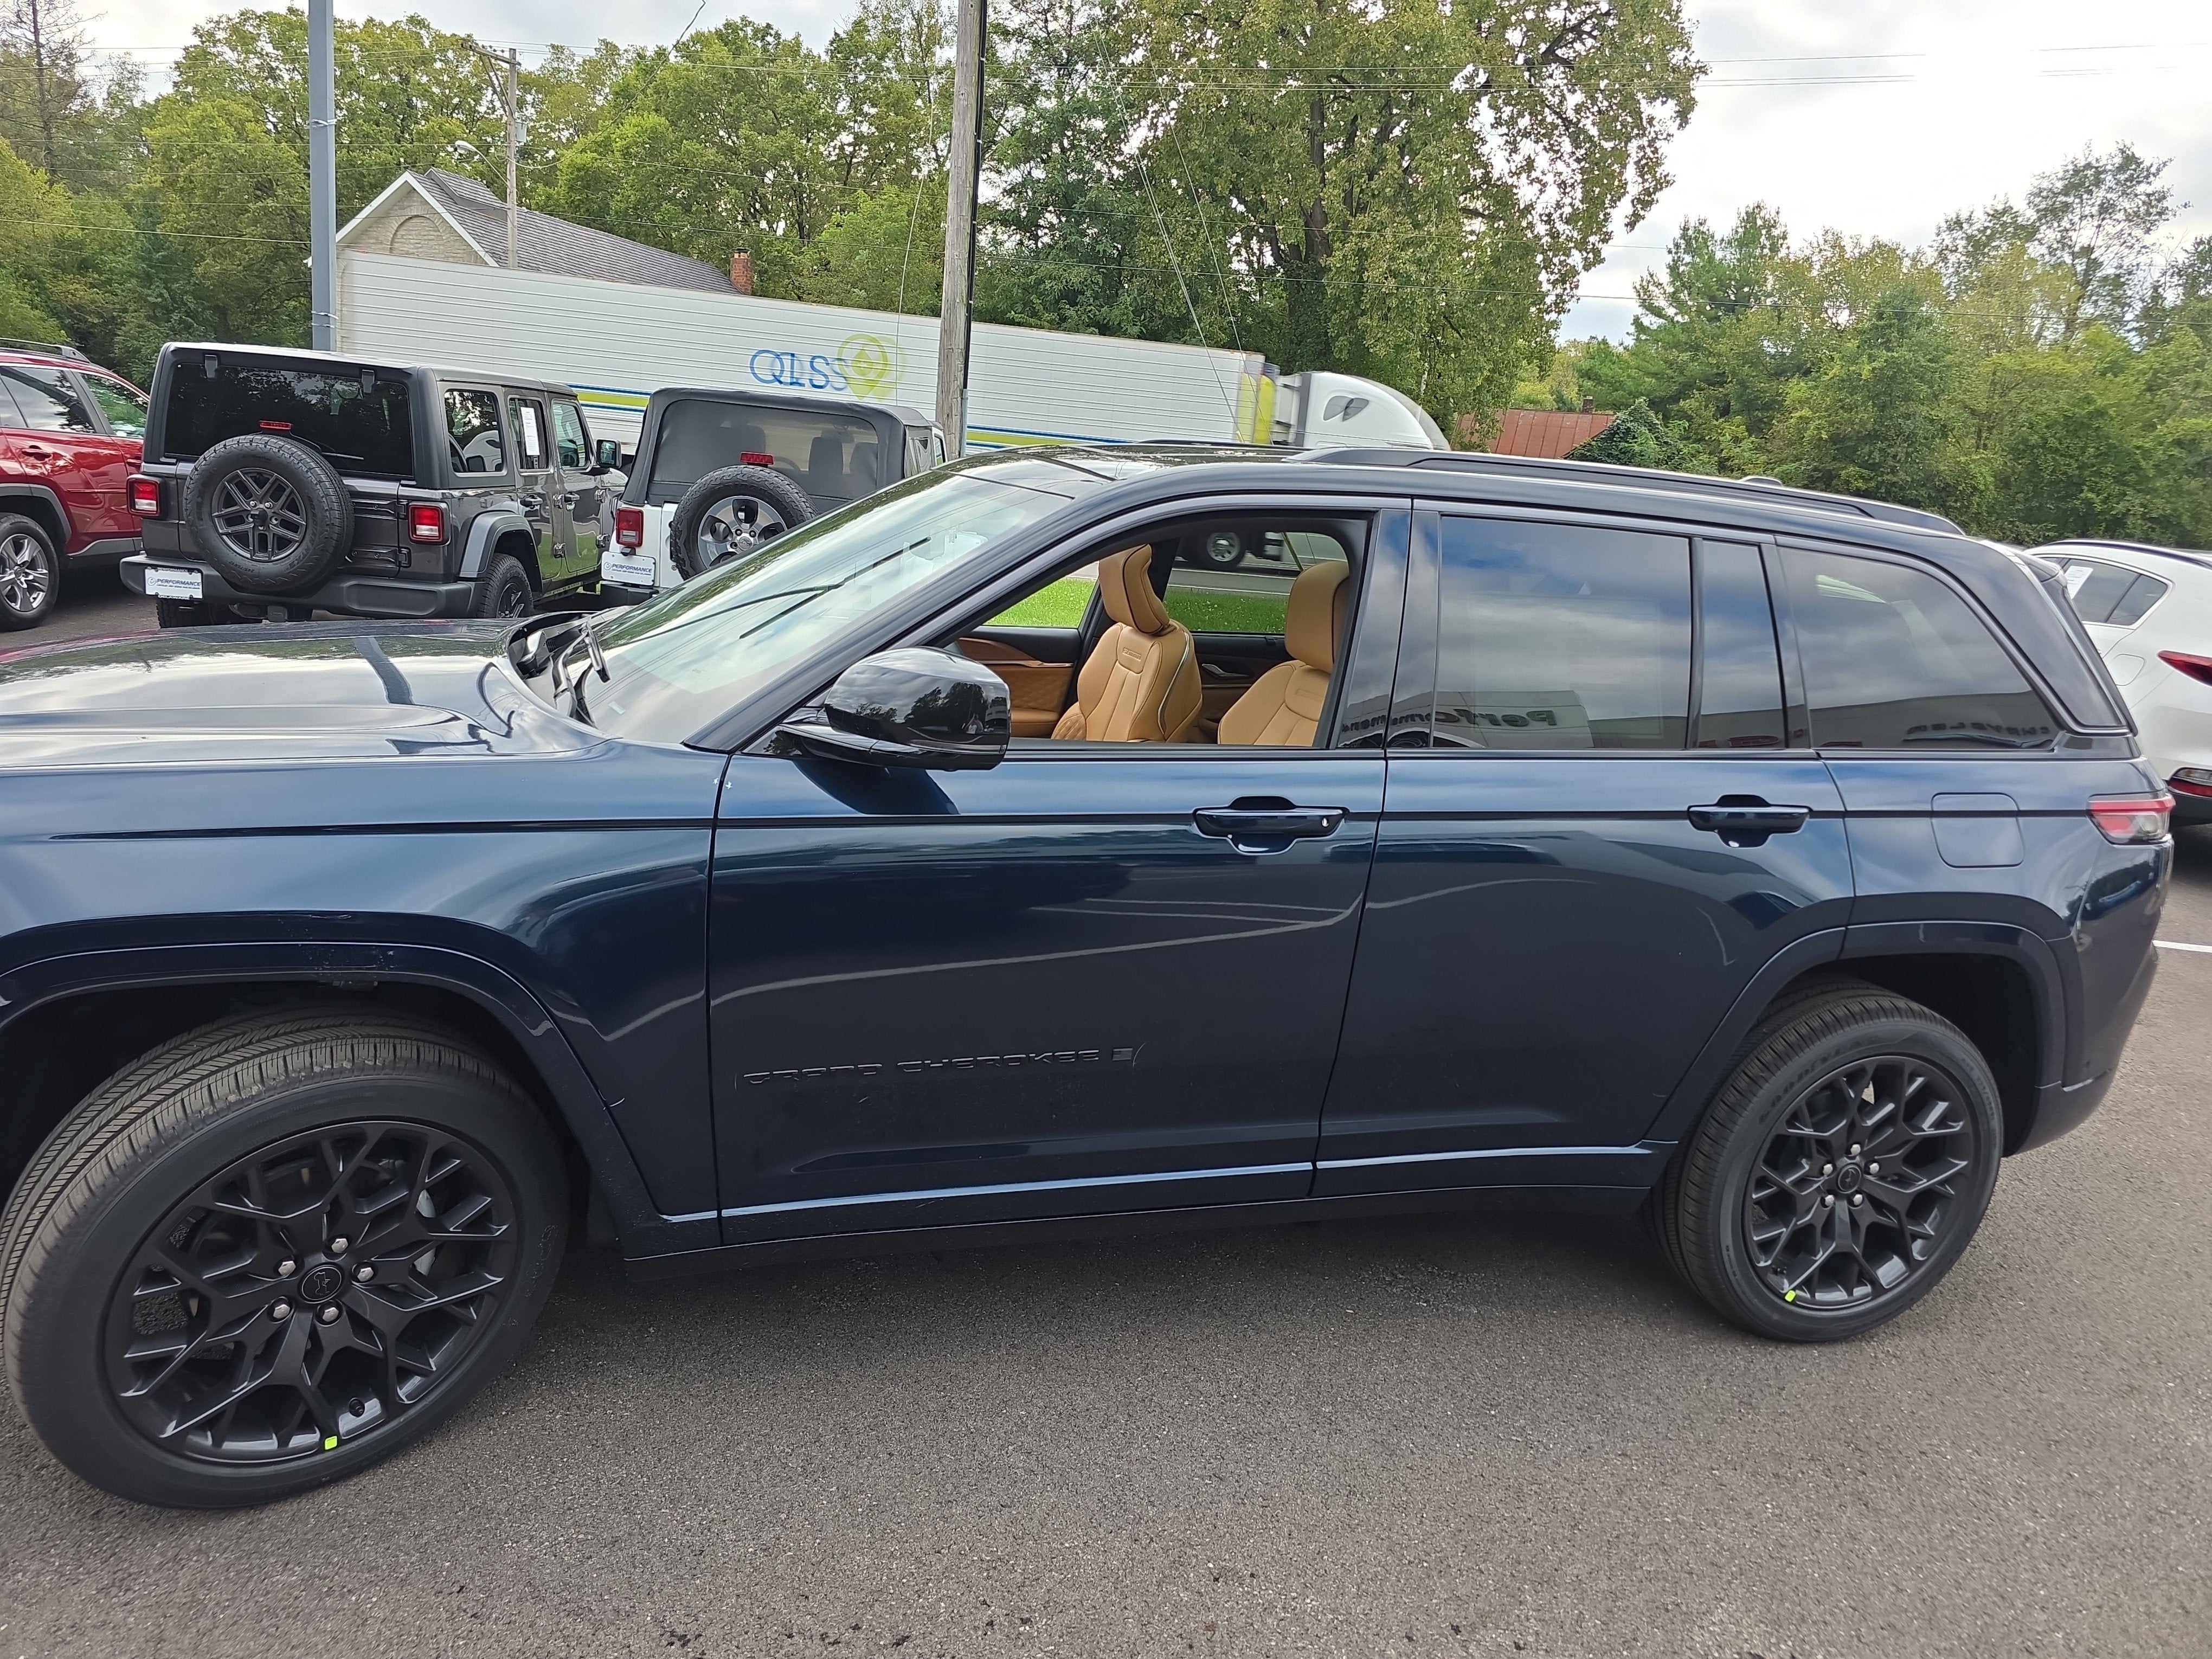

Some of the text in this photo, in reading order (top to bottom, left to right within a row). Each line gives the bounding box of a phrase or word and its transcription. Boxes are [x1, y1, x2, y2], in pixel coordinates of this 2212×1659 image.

[612, 563, 653, 573] PERFORMANCE
[157, 578, 201, 587] PERFORMANCE
[897, 1050, 1099, 1072] CHEROKEE
